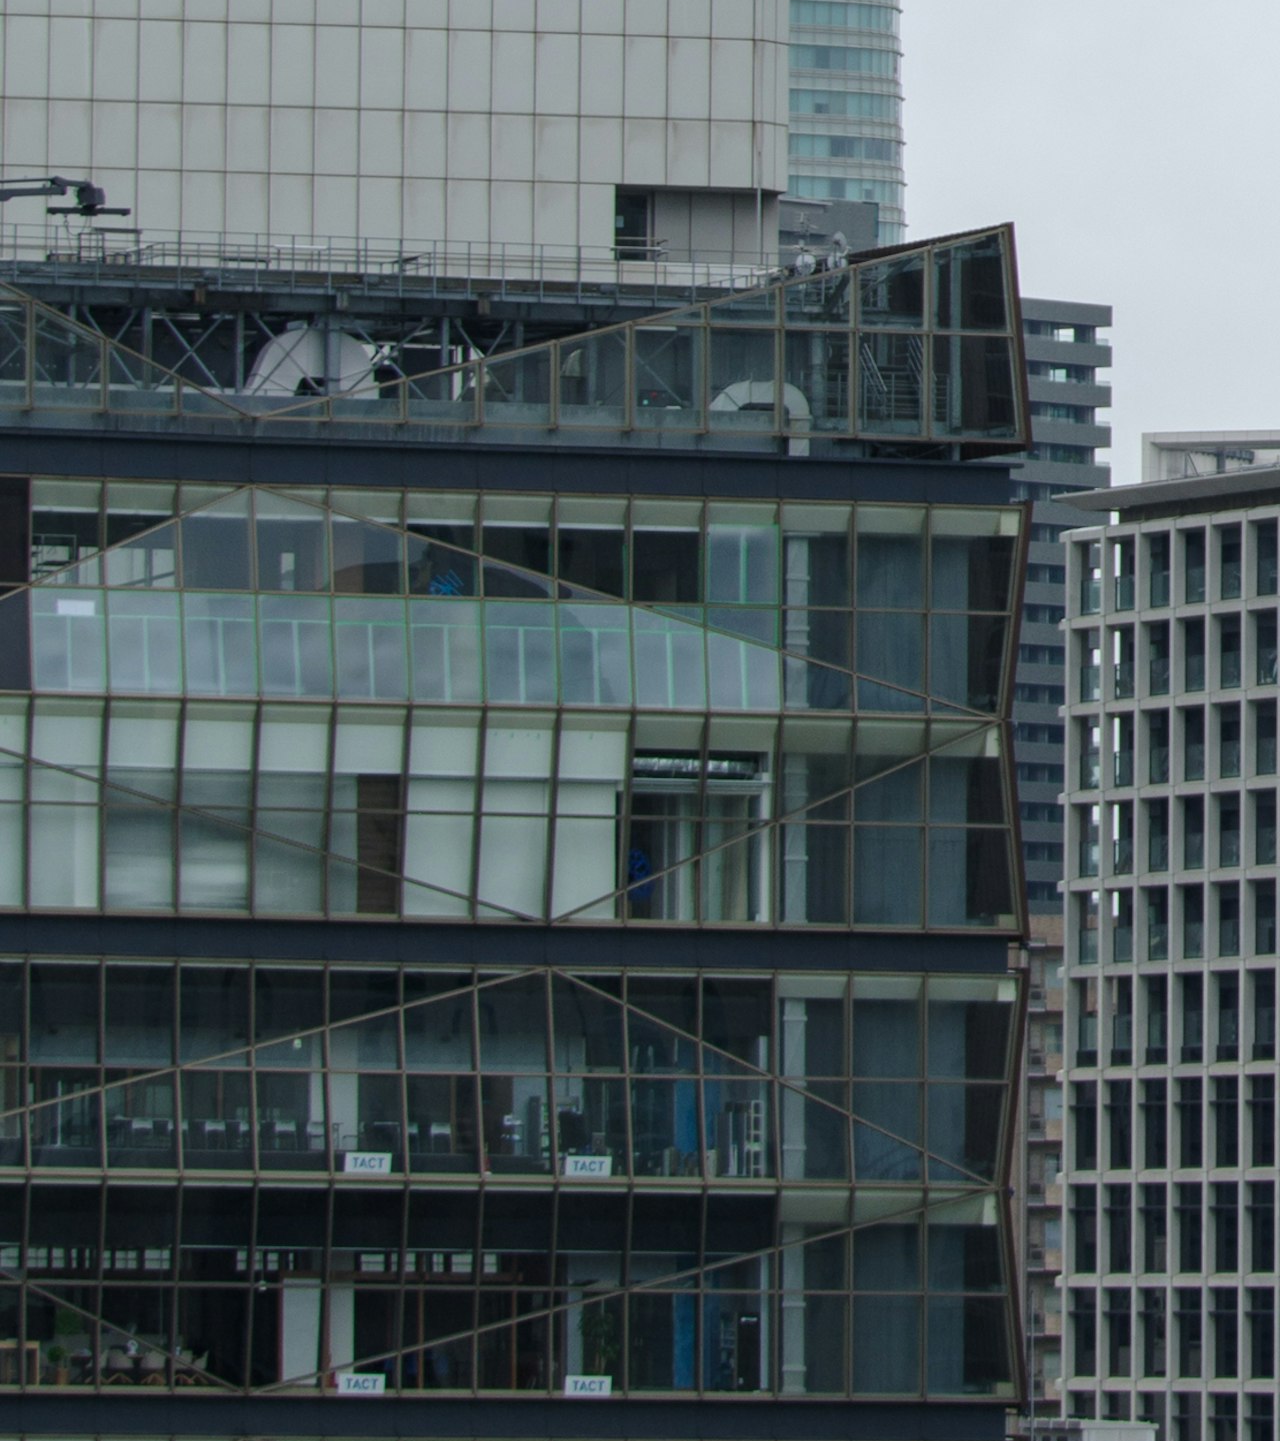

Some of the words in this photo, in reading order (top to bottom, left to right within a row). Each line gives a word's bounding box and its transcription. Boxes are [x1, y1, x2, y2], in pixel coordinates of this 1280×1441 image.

[352, 1156, 385, 1169] TACT
[573, 1159, 606, 1172] TACT
[346, 1377, 378, 1390] TACT
[572, 1379, 606, 1392] TACT
